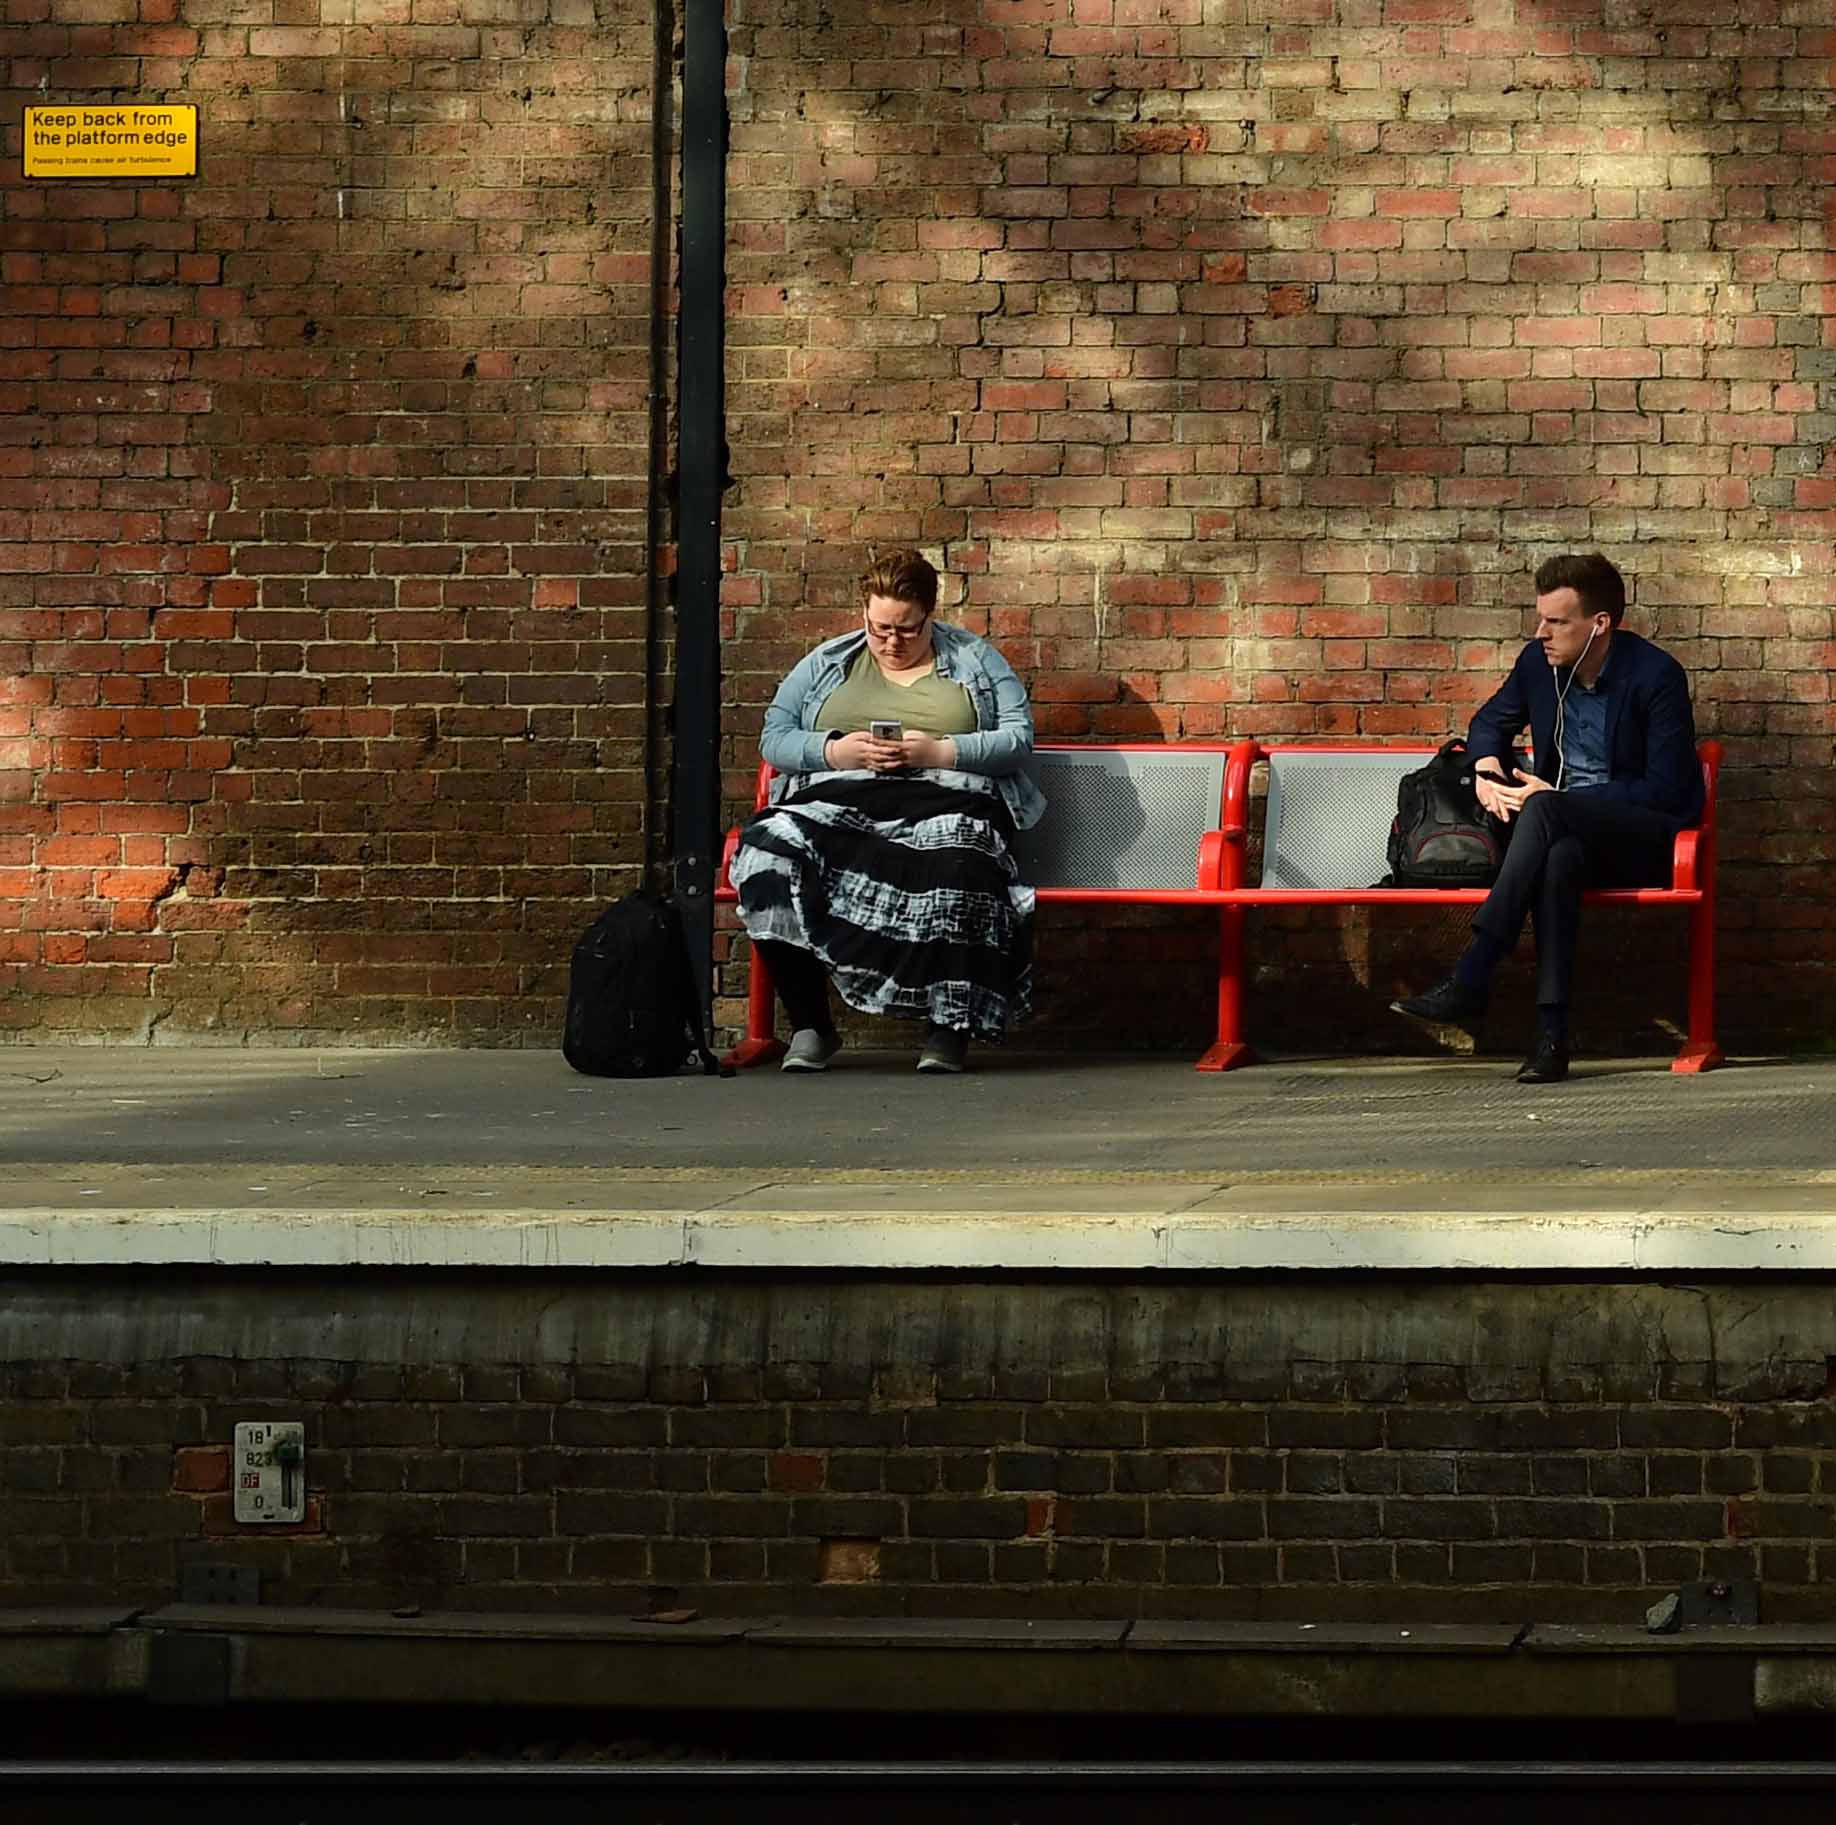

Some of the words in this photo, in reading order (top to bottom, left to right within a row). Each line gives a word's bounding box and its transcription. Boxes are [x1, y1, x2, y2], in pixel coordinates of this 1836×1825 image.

[32, 112, 77, 127] Keep
[83, 112, 126, 126] back
[133, 112, 173, 126] from
[33, 130, 61, 145] the
[66, 130, 140, 148] platform
[143, 130, 188, 147] edge
[248, 1430, 264, 1445] 18
